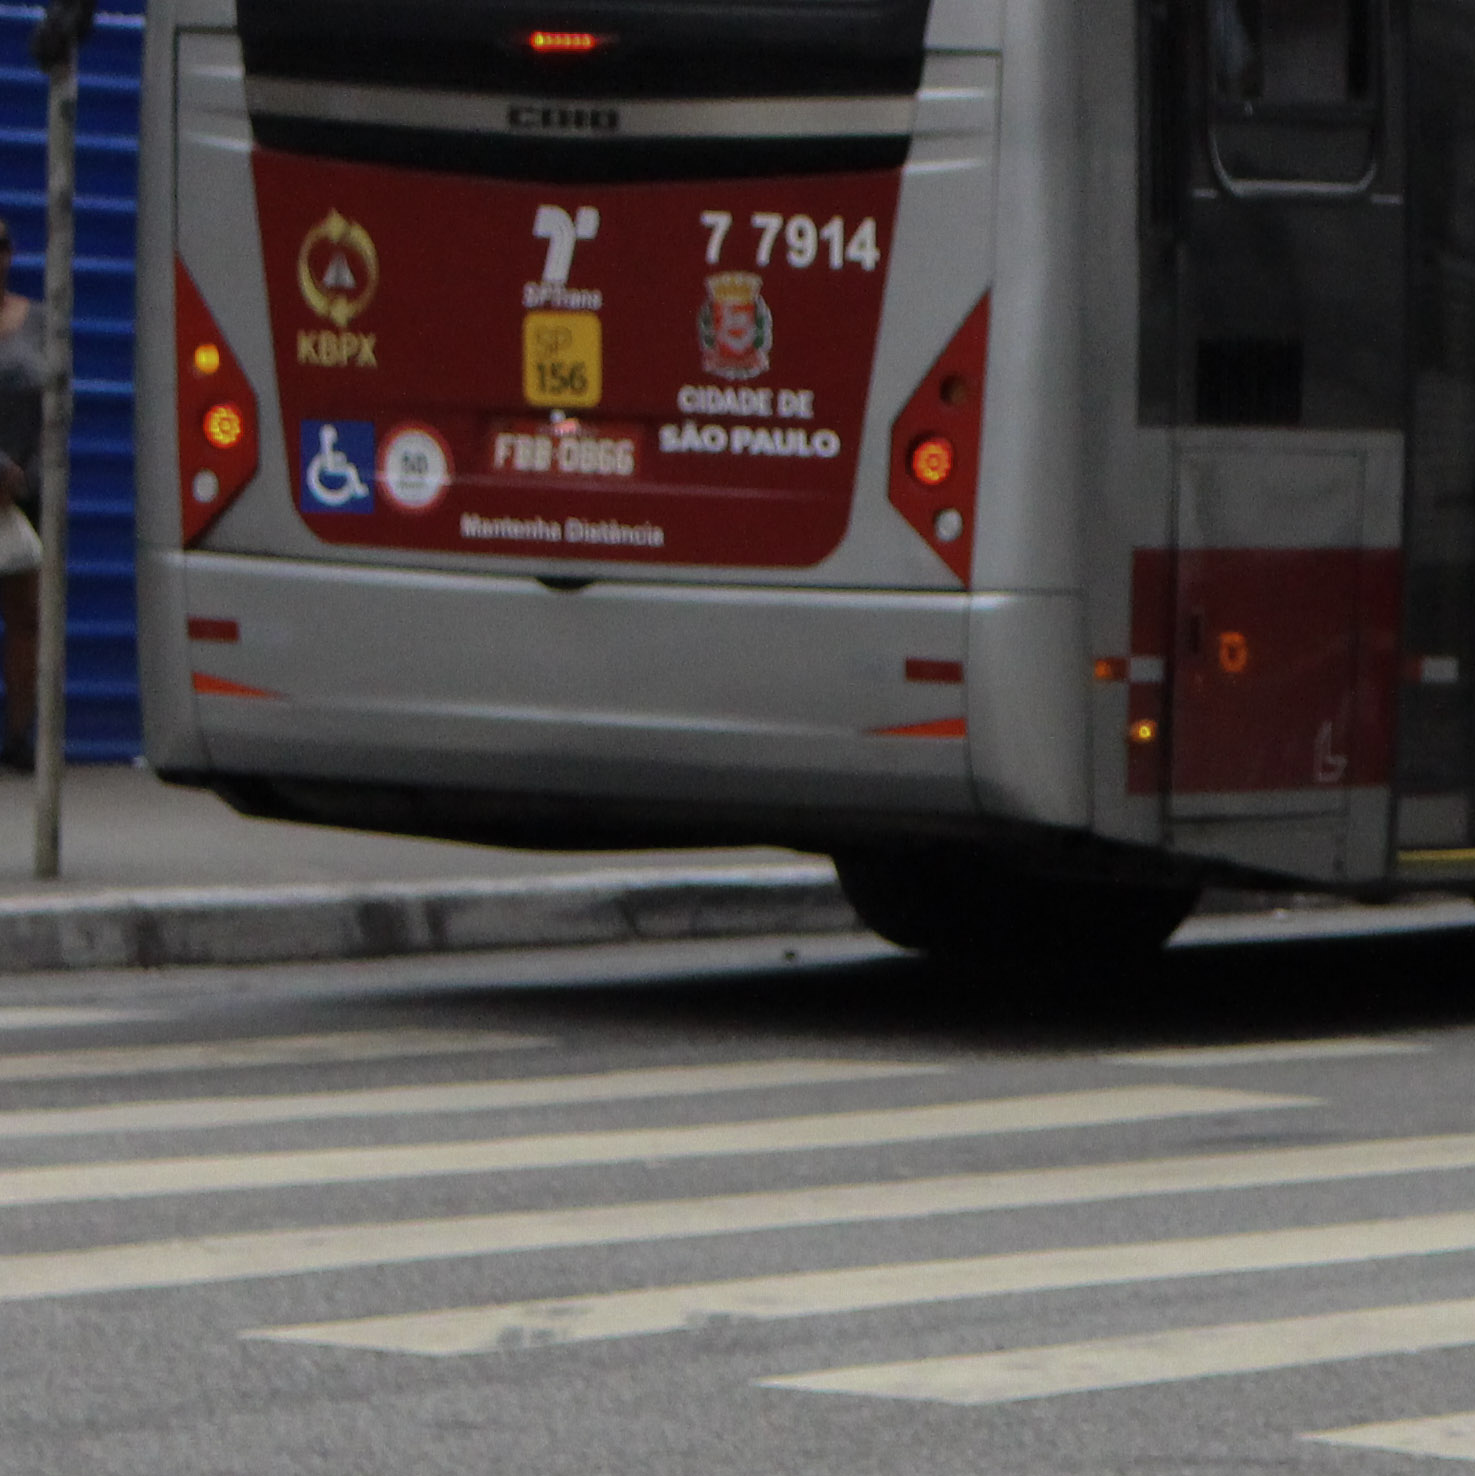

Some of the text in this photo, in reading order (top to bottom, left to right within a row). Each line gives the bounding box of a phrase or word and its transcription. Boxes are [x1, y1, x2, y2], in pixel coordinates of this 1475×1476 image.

[700, 209, 880, 271] 7 7914
[297, 329, 377, 367] KBPX
[536, 361, 588, 395] 156
[677, 384, 815, 419] CIDADE DE
[659, 417, 841, 458] SÃO PAULO
[460, 512, 665, 547] Mantenha Distância
